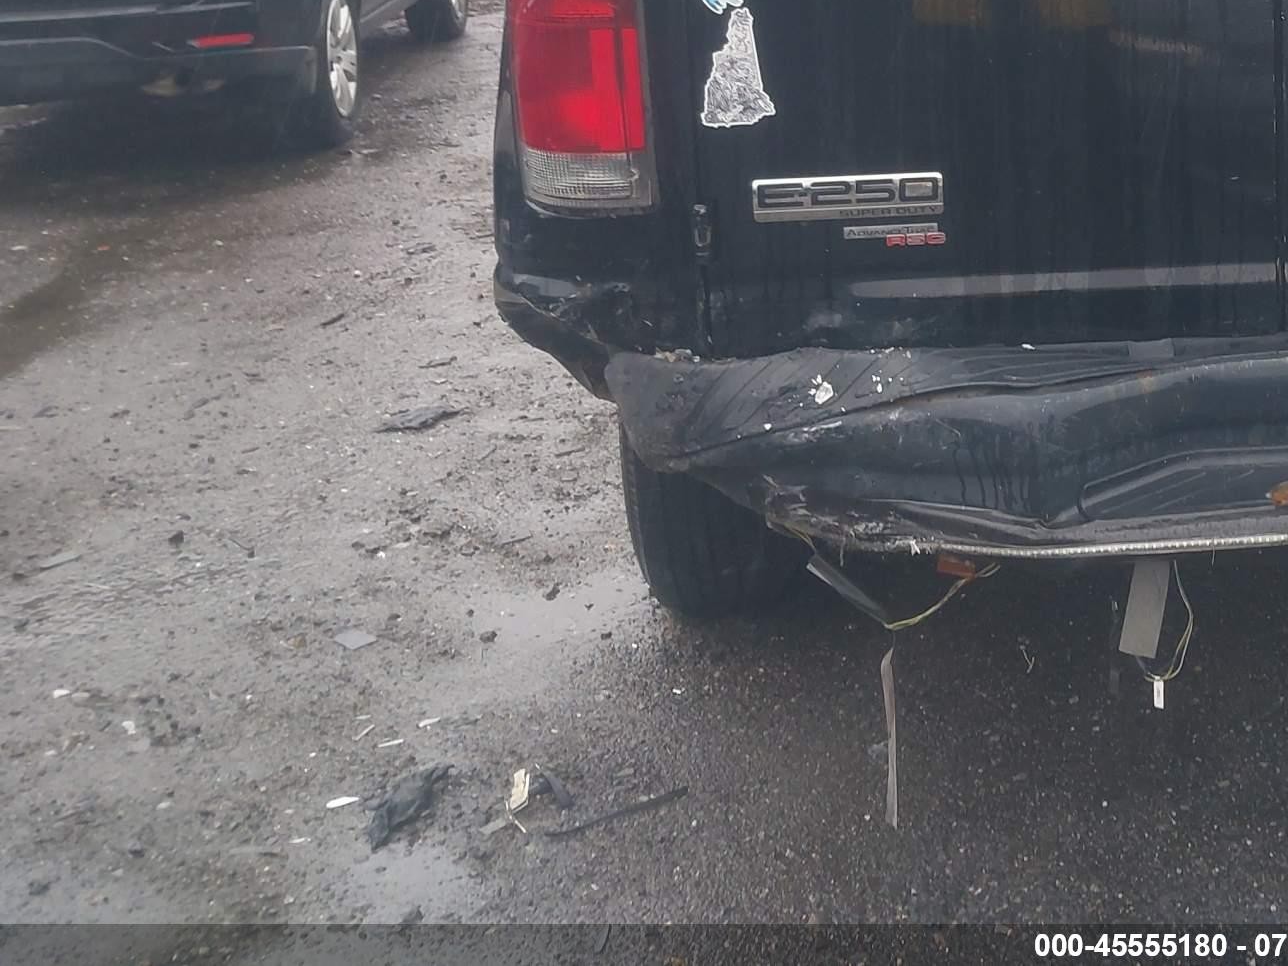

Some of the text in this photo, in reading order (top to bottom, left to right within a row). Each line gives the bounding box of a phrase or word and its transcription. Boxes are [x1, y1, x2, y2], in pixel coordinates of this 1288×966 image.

[757, 176, 939, 208] E-250
[839, 205, 937, 218] SUPER DUTY
[886, 231, 946, 247] RSC
